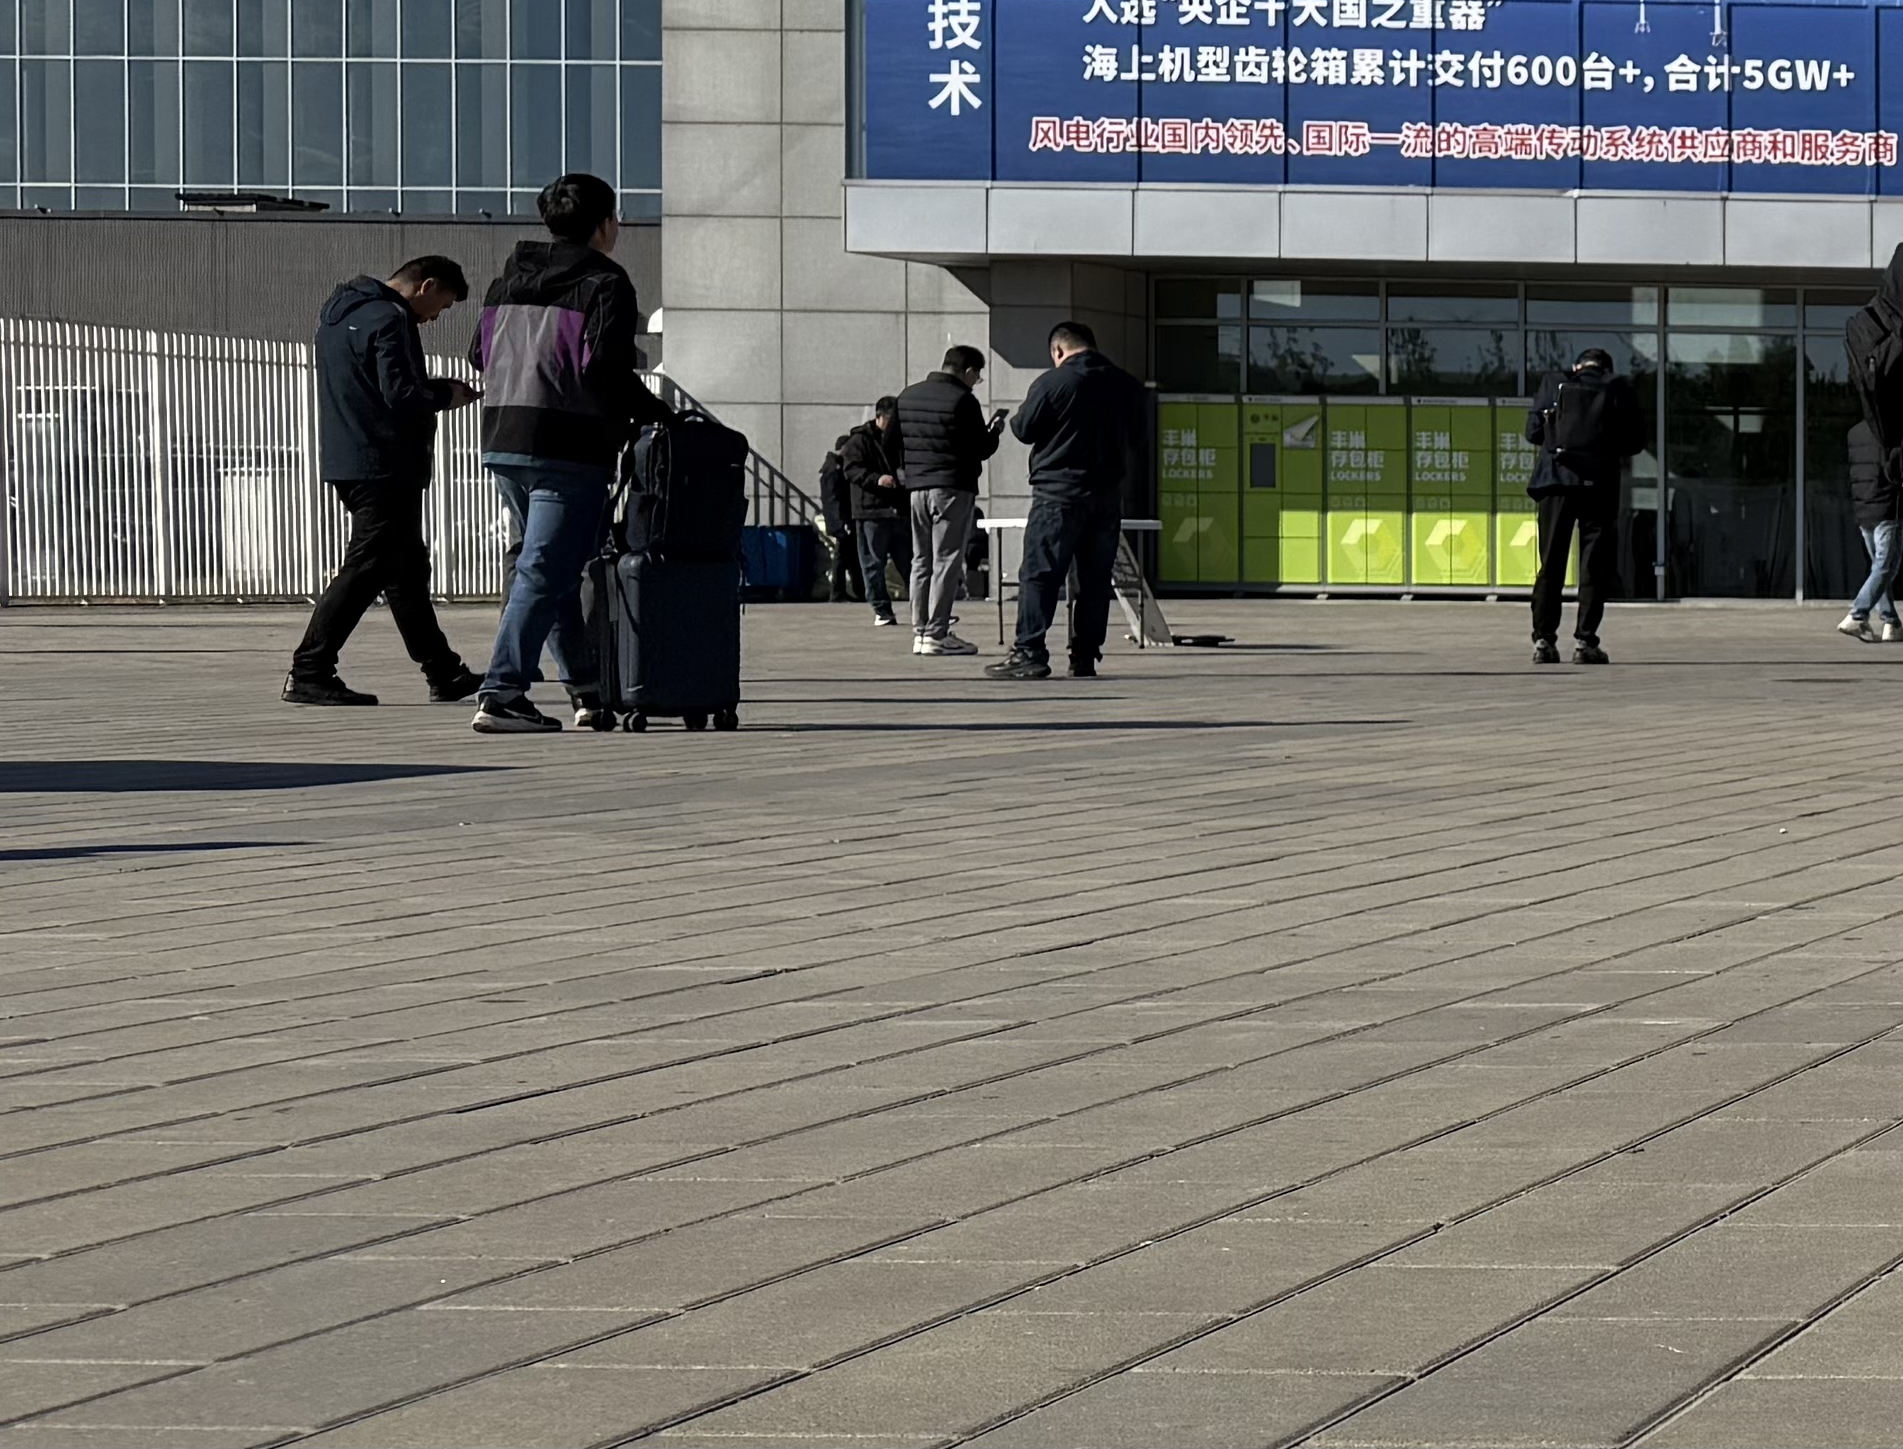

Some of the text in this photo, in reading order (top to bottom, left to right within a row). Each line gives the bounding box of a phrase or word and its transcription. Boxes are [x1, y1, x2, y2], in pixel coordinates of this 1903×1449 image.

[1162, 468, 1213, 479] LOCKERS
[1331, 471, 1381, 481] LOCKERS
[1416, 472, 1466, 482] LOCKERS
